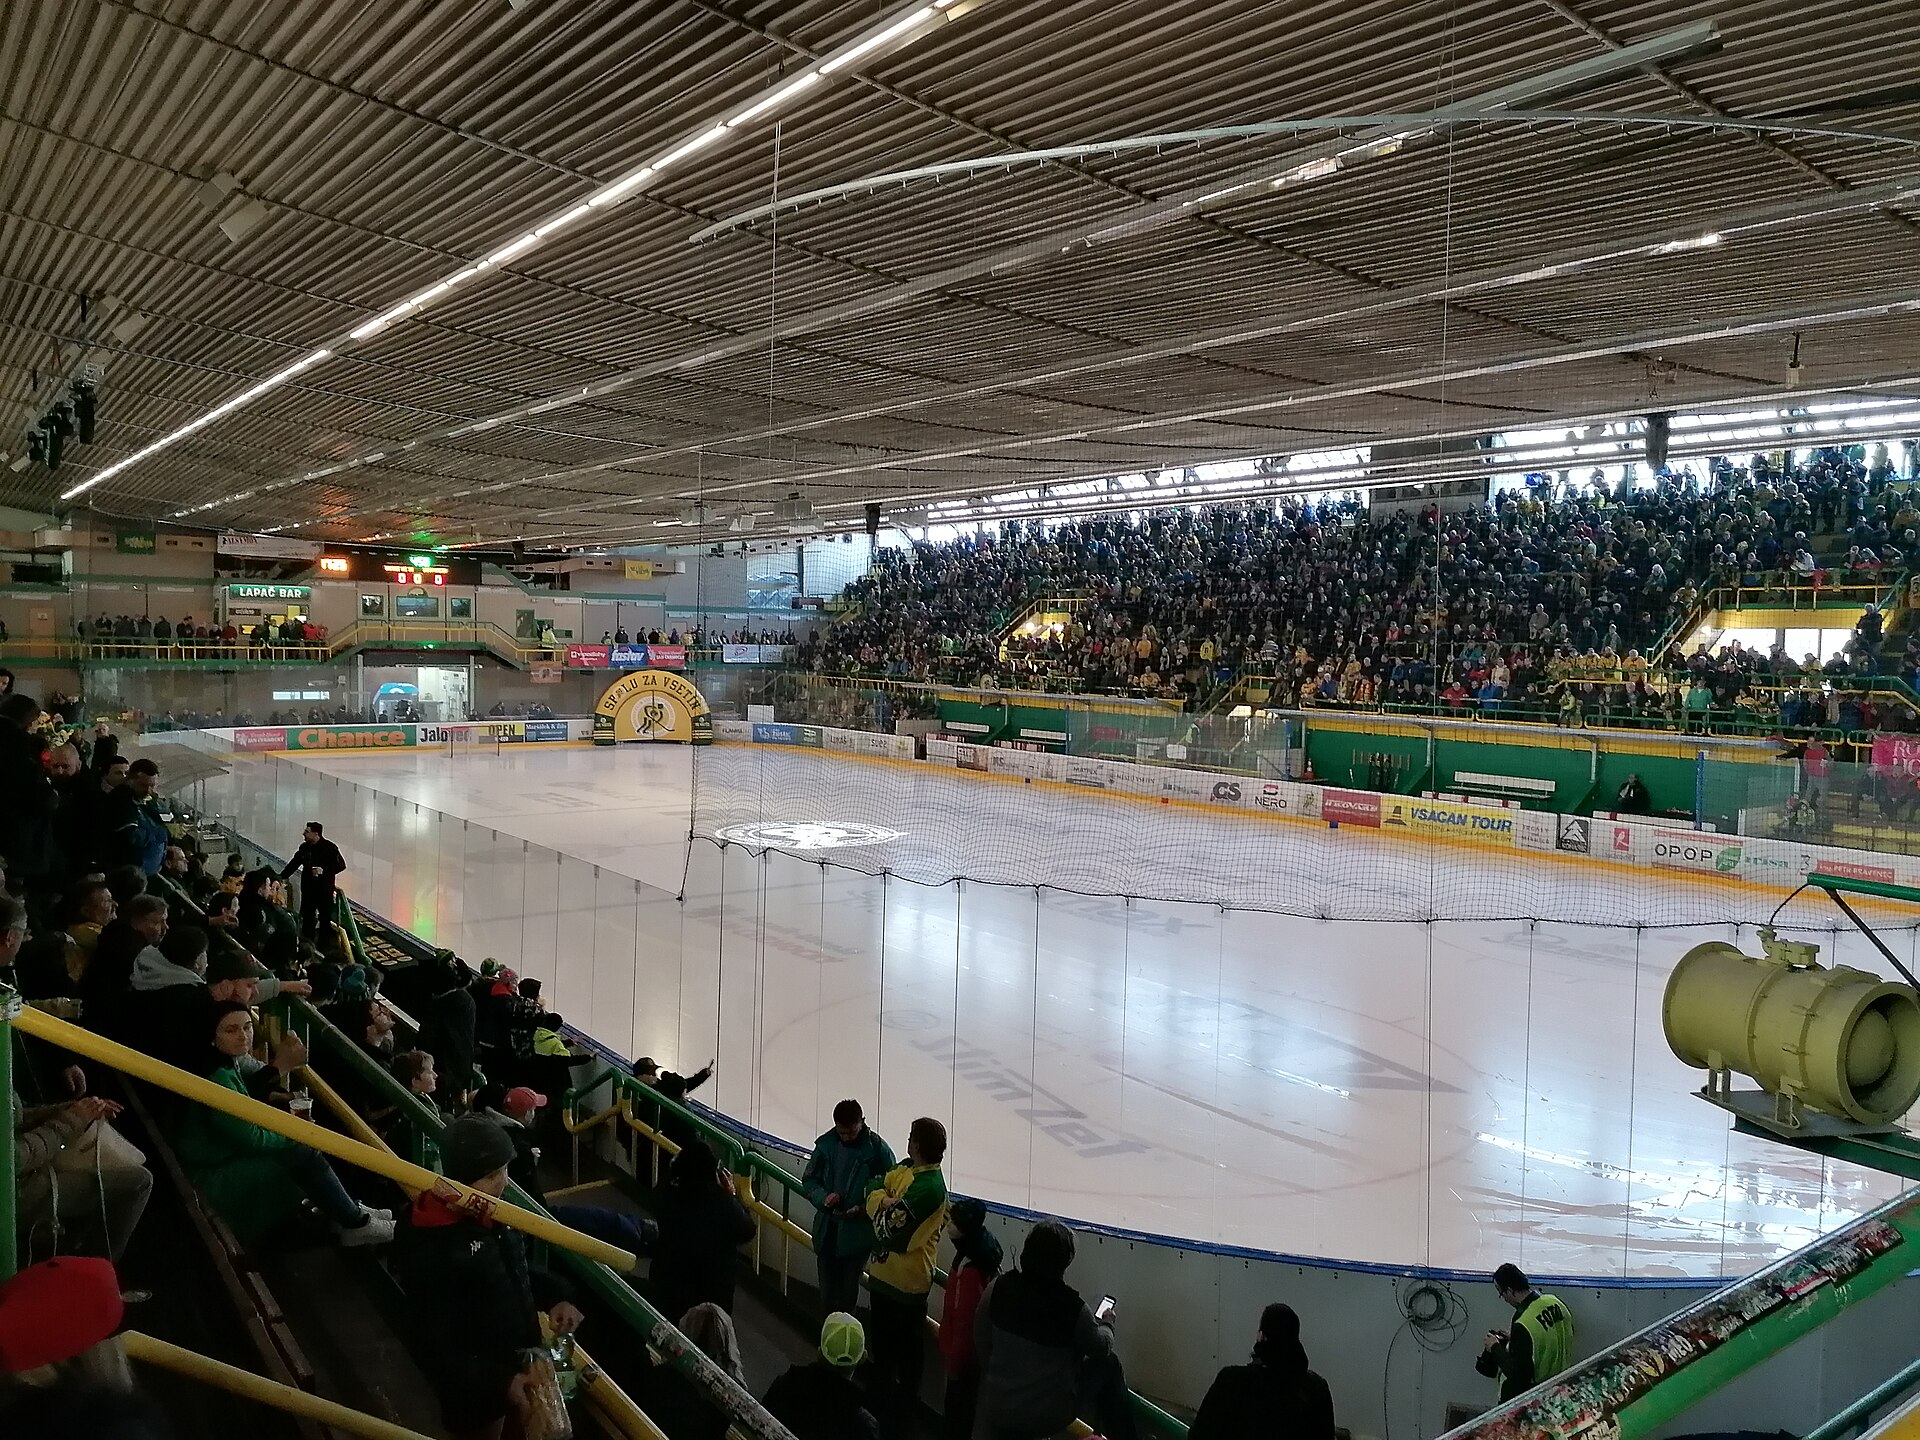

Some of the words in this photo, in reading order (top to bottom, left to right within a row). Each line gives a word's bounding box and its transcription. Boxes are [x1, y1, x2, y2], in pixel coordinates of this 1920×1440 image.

[239, 586, 276, 598] LAPAČ
[279, 588, 302, 598] BAR
[642, 675, 658, 686] ZA
[663, 676, 701, 711] VSETÍN
[298, 729, 406, 749] Chance
[488, 723, 516, 737] OPEN
[1254, 796, 1287, 809] NERO
[1411, 807, 1466, 826] VSACAN
[1471, 815, 1513, 833] TOUR
[1654, 843, 1713, 862] OPOP
[1535, 1303, 1564, 1332] FOTO
